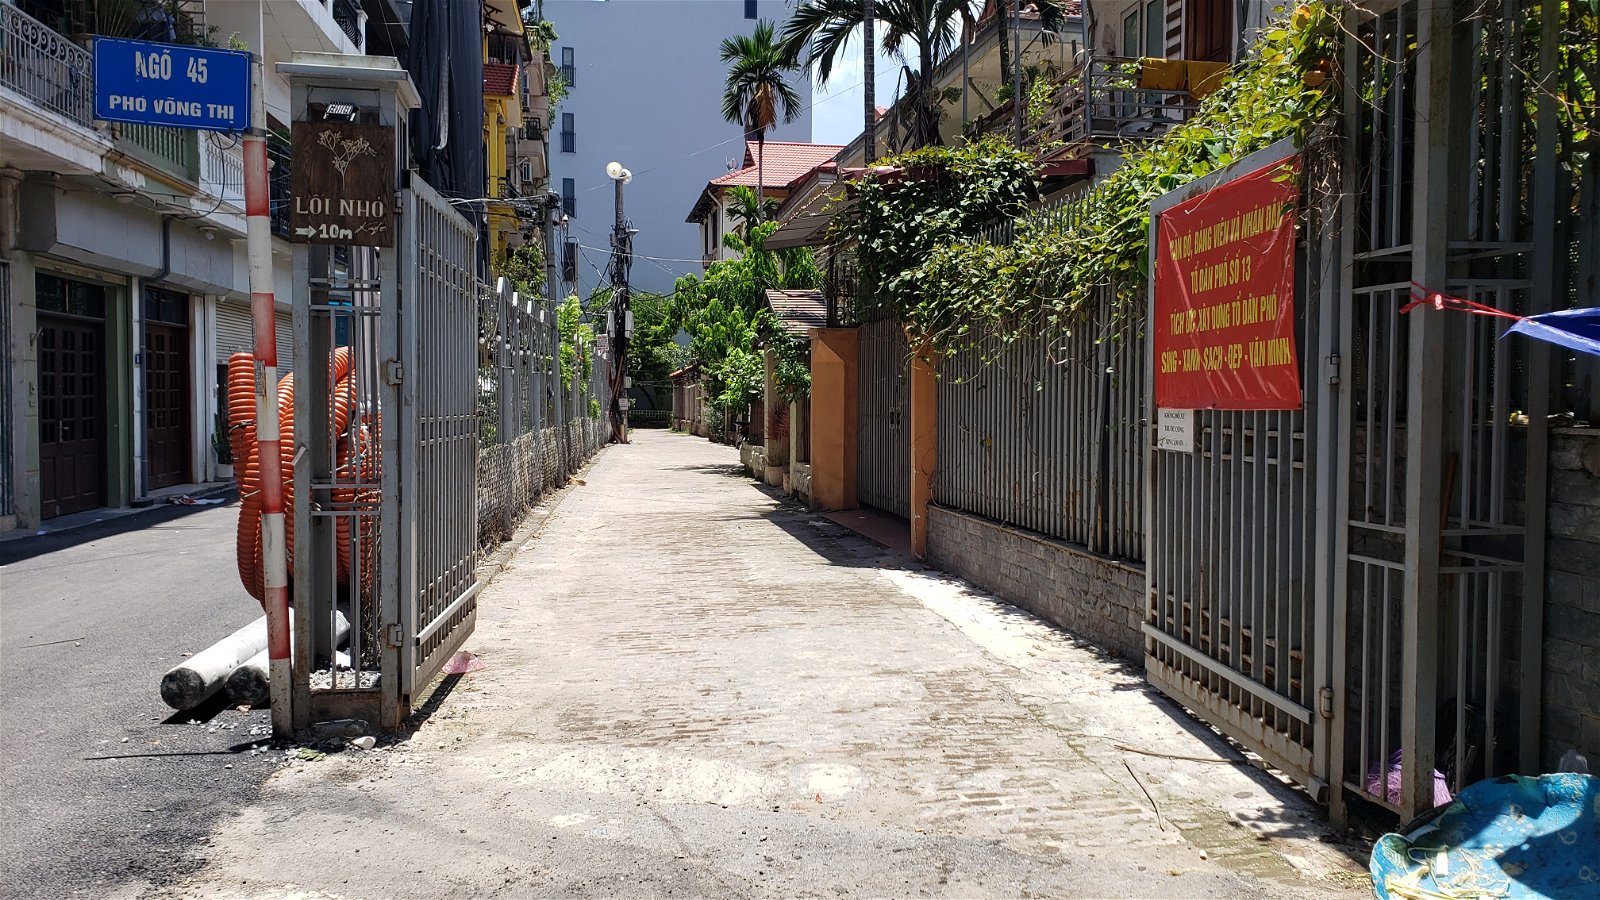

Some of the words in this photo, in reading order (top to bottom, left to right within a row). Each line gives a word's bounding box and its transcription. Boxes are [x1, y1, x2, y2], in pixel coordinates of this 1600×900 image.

[135, 49, 172, 81] NGÕ
[187, 57, 208, 84] 45
[153, 96, 202, 117] VÕNG
[207, 104, 235, 124] THỊ
[295, 193, 331, 216] LỐI
[318, 223, 353, 240] 10m
[1213, 216, 1229, 249] VIÊN
[1241, 204, 1264, 240] NHÂN
[1199, 262, 1213, 292] DÂN
[1214, 252, 1228, 288] PHỐ
[1229, 248, 1240, 285] SỐ
[1242, 255, 1251, 282] 13
[1170, 308, 1185, 336] TÍCH
[1197, 302, 1211, 332] XÂY
[1211, 301, 1230, 335] DỰNG
[1242, 292, 1259, 325] DÂN
[1260, 283, 1278, 322] PHỐ
[1161, 346, 1178, 374] SÁNG
[1182, 348, 1200, 372] XANH
[1203, 345, 1223, 376] SẠCH
[1227, 343, 1243, 375] ĐẸP
[1249, 335, 1266, 368] VĂN
[1267, 337, 1291, 367] MINH
